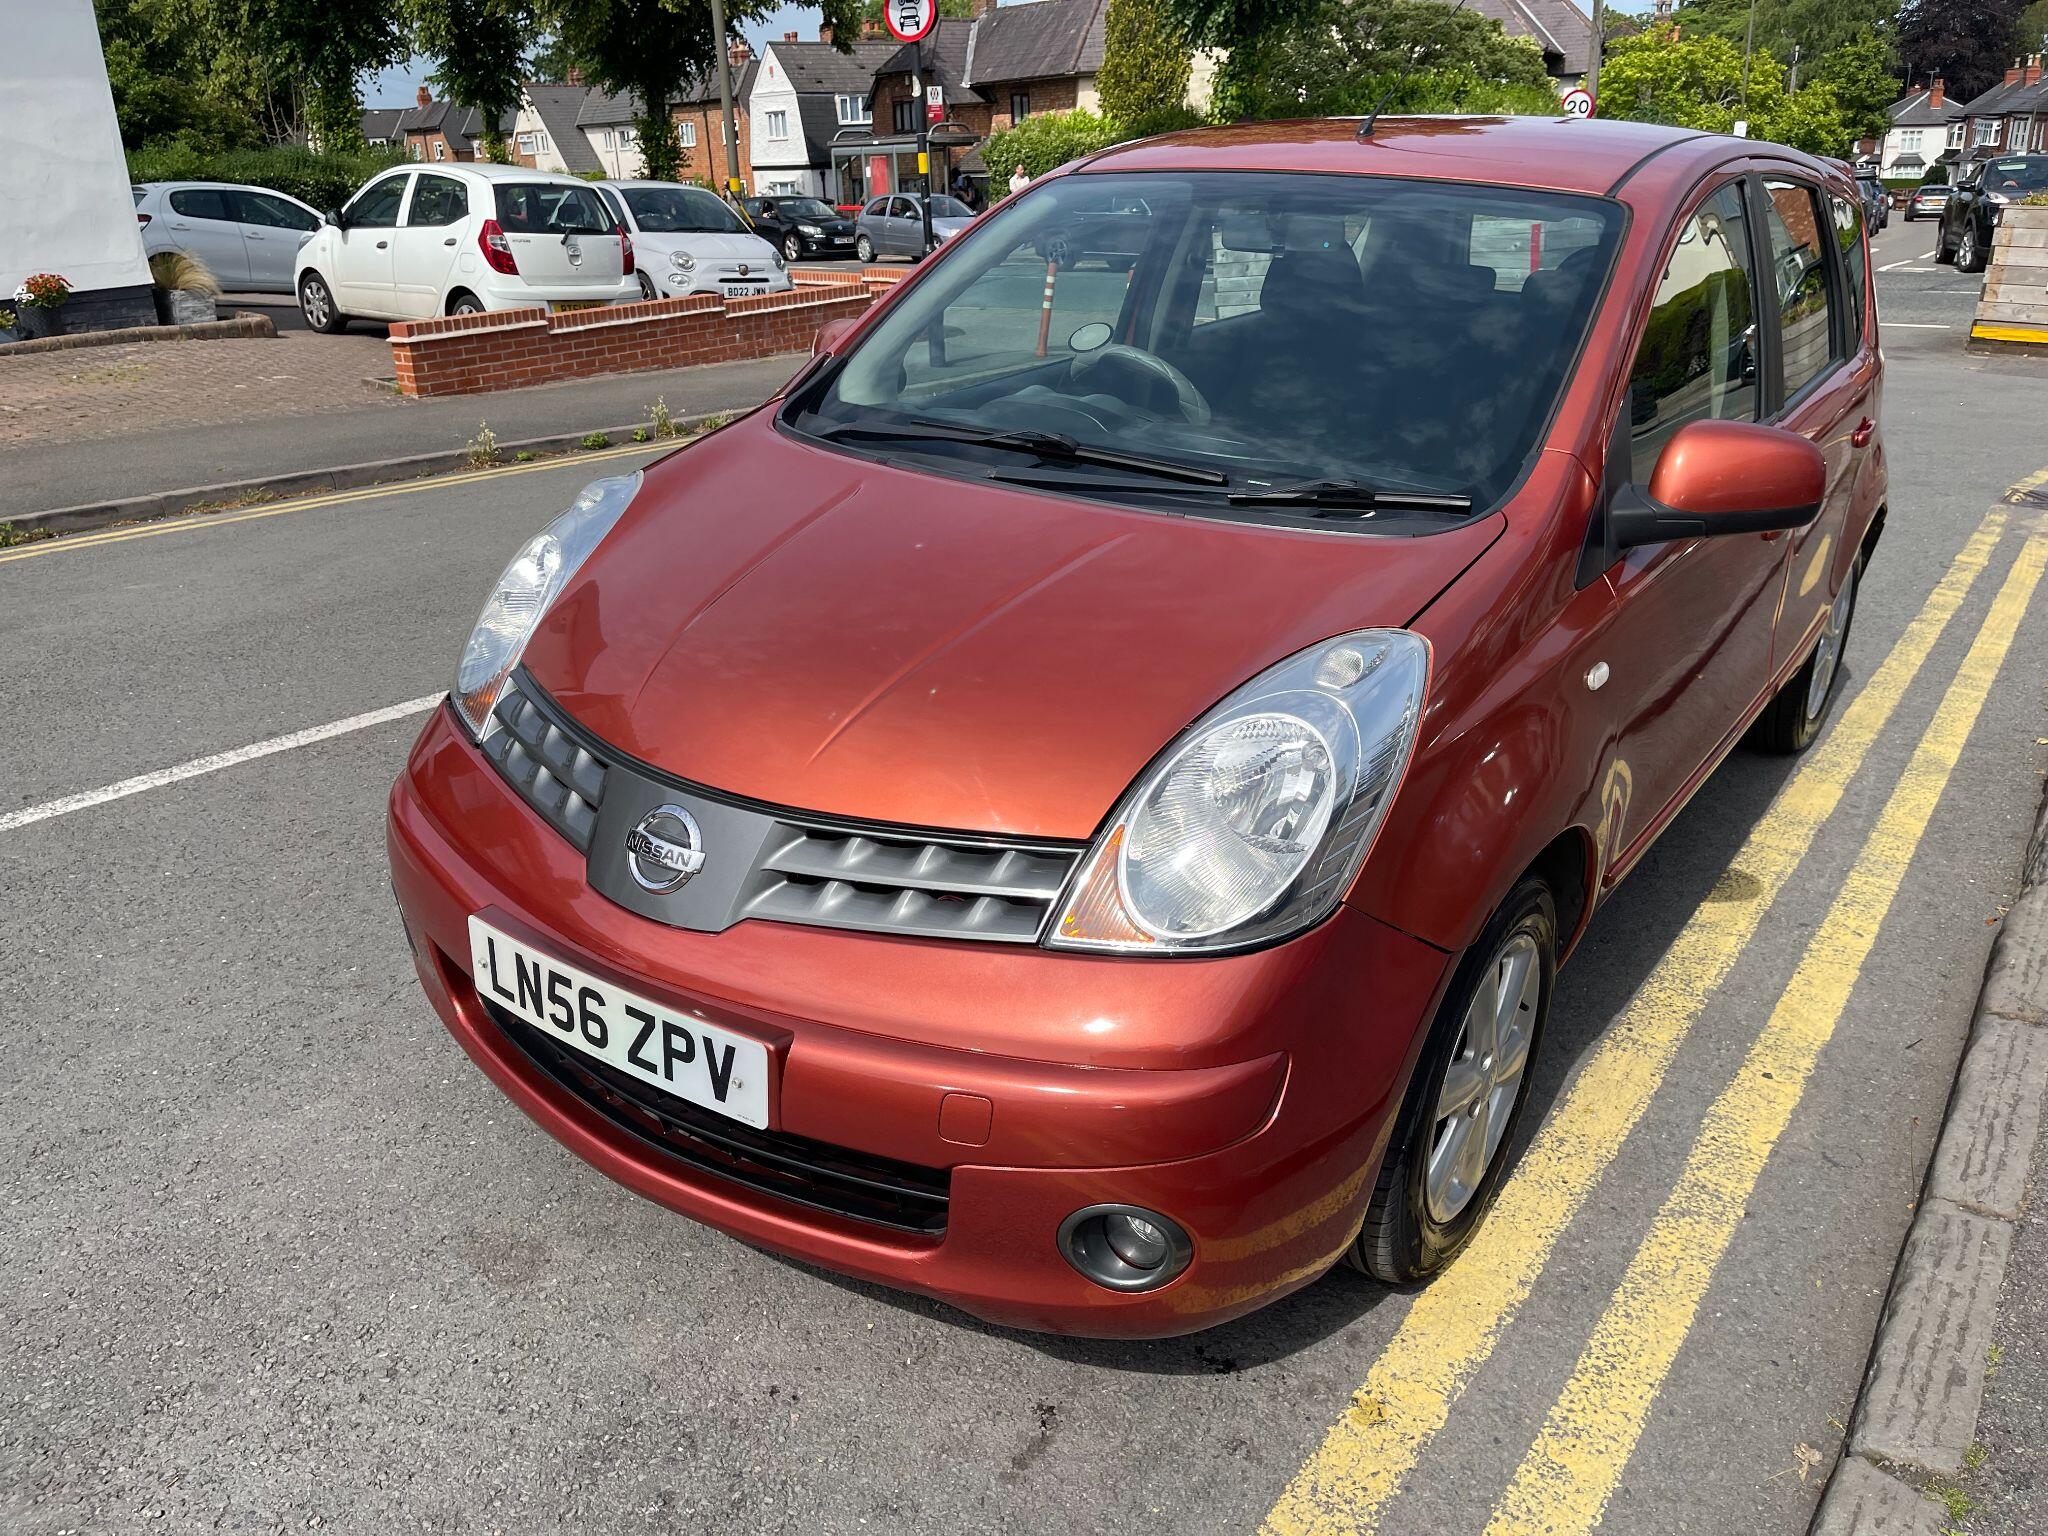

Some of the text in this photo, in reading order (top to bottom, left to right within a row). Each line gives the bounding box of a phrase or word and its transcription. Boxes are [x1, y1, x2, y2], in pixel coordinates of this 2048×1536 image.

[1567, 100, 1589, 114] 20
[727, 287, 749, 296] BD22
[627, 832, 692, 868] NISSAN
[487, 936, 736, 1103] LN56 ZPV
